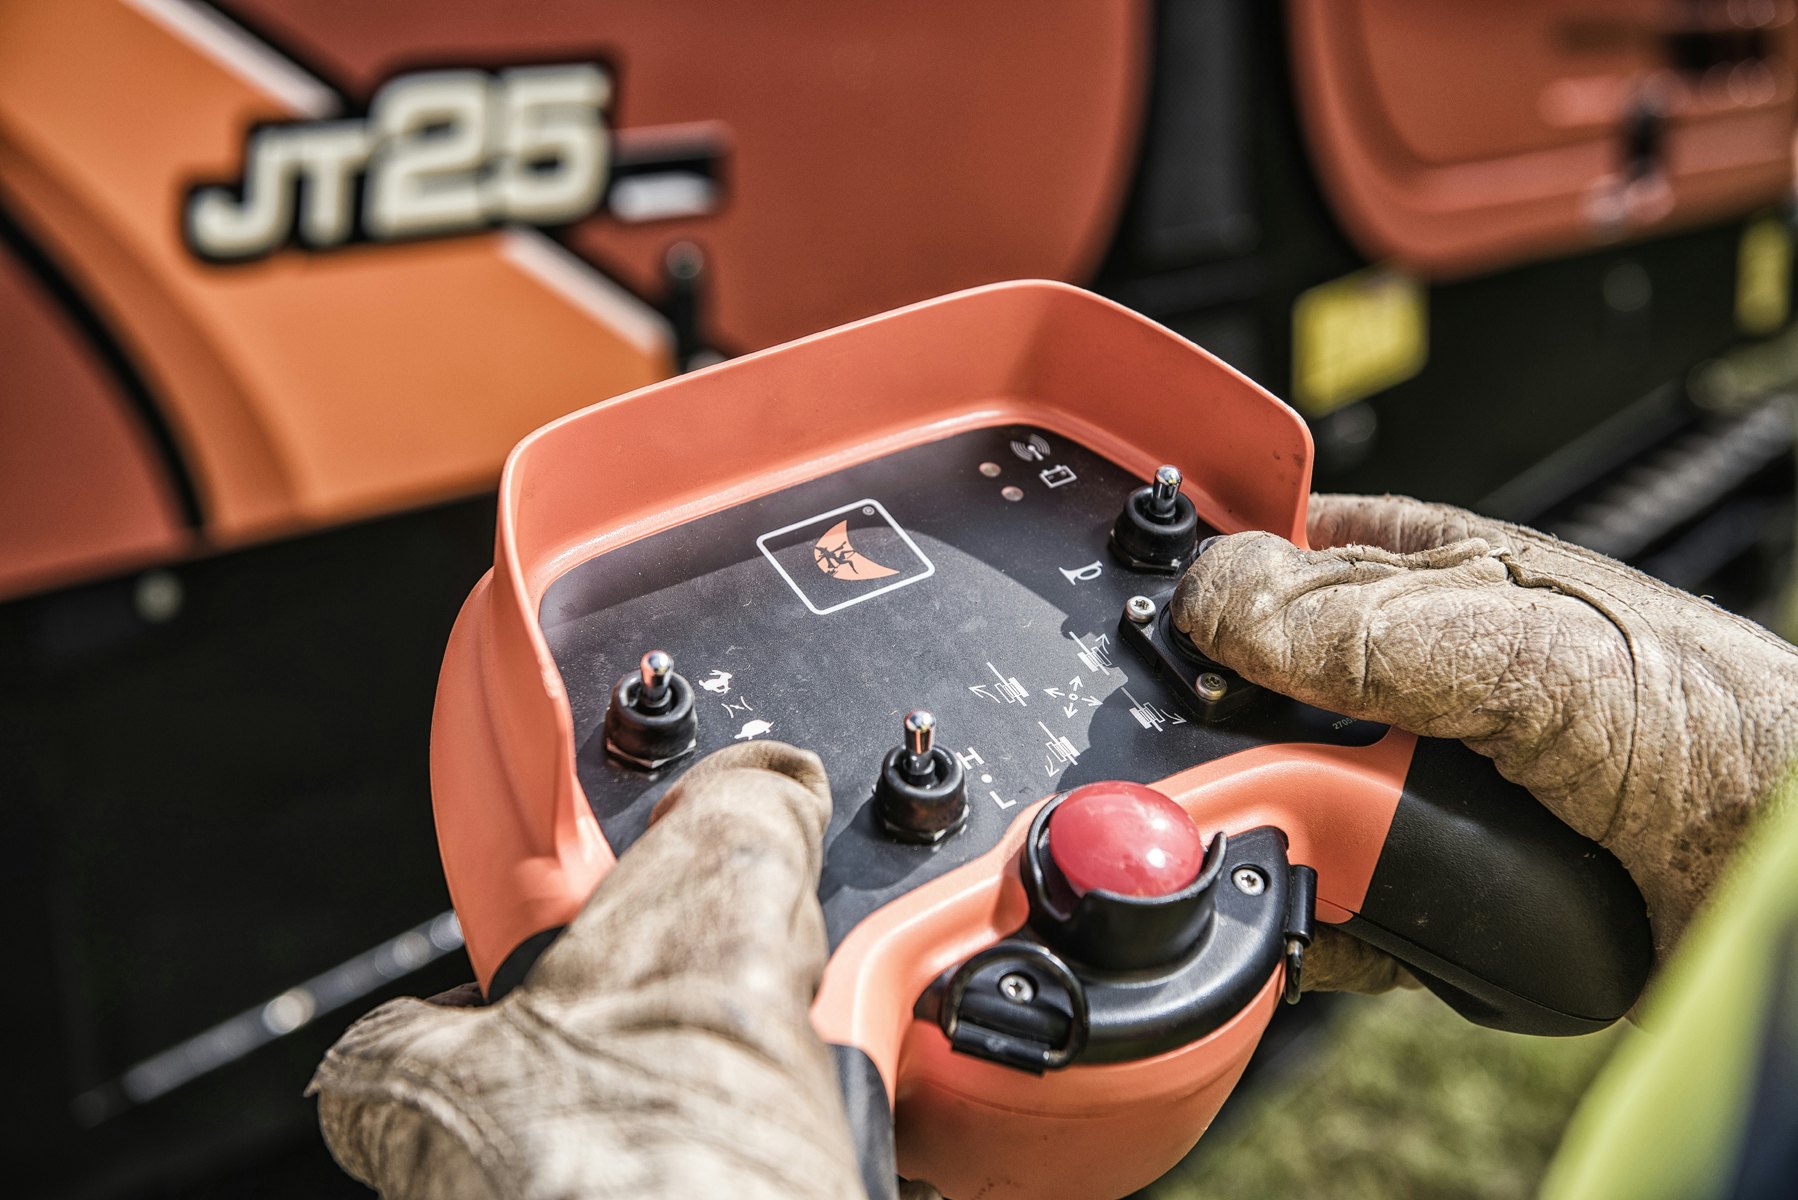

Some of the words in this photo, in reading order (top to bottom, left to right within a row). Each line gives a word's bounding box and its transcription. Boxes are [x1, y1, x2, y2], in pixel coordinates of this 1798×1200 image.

[188, 63, 613, 256] JT25
[956, 747, 985, 770] H
[989, 790, 1017, 810] L
